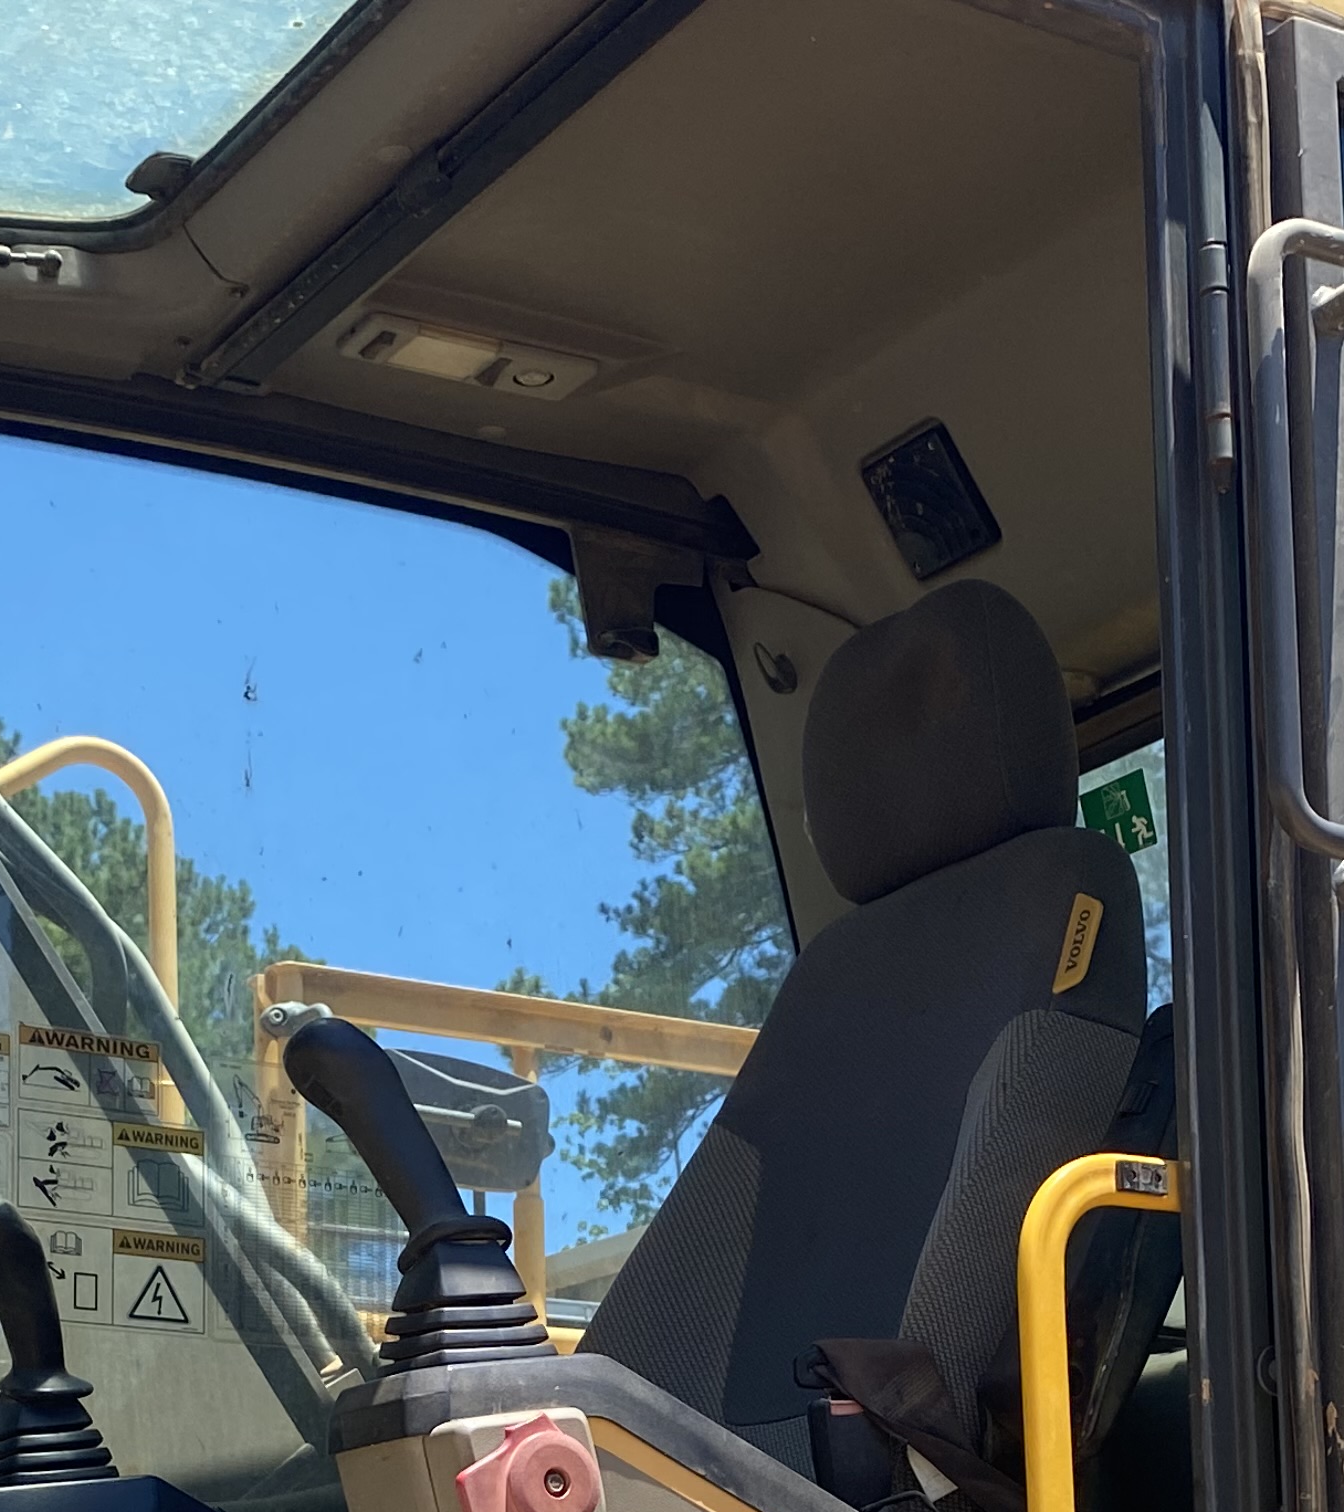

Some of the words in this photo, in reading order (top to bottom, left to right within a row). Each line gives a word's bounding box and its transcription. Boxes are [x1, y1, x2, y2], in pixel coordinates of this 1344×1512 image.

[1065, 910, 1090, 973] VOLVO
[45, 1031, 150, 1058] WARNING
[132, 1130, 199, 1149] WARNING
[133, 1237, 200, 1256] WARNING
